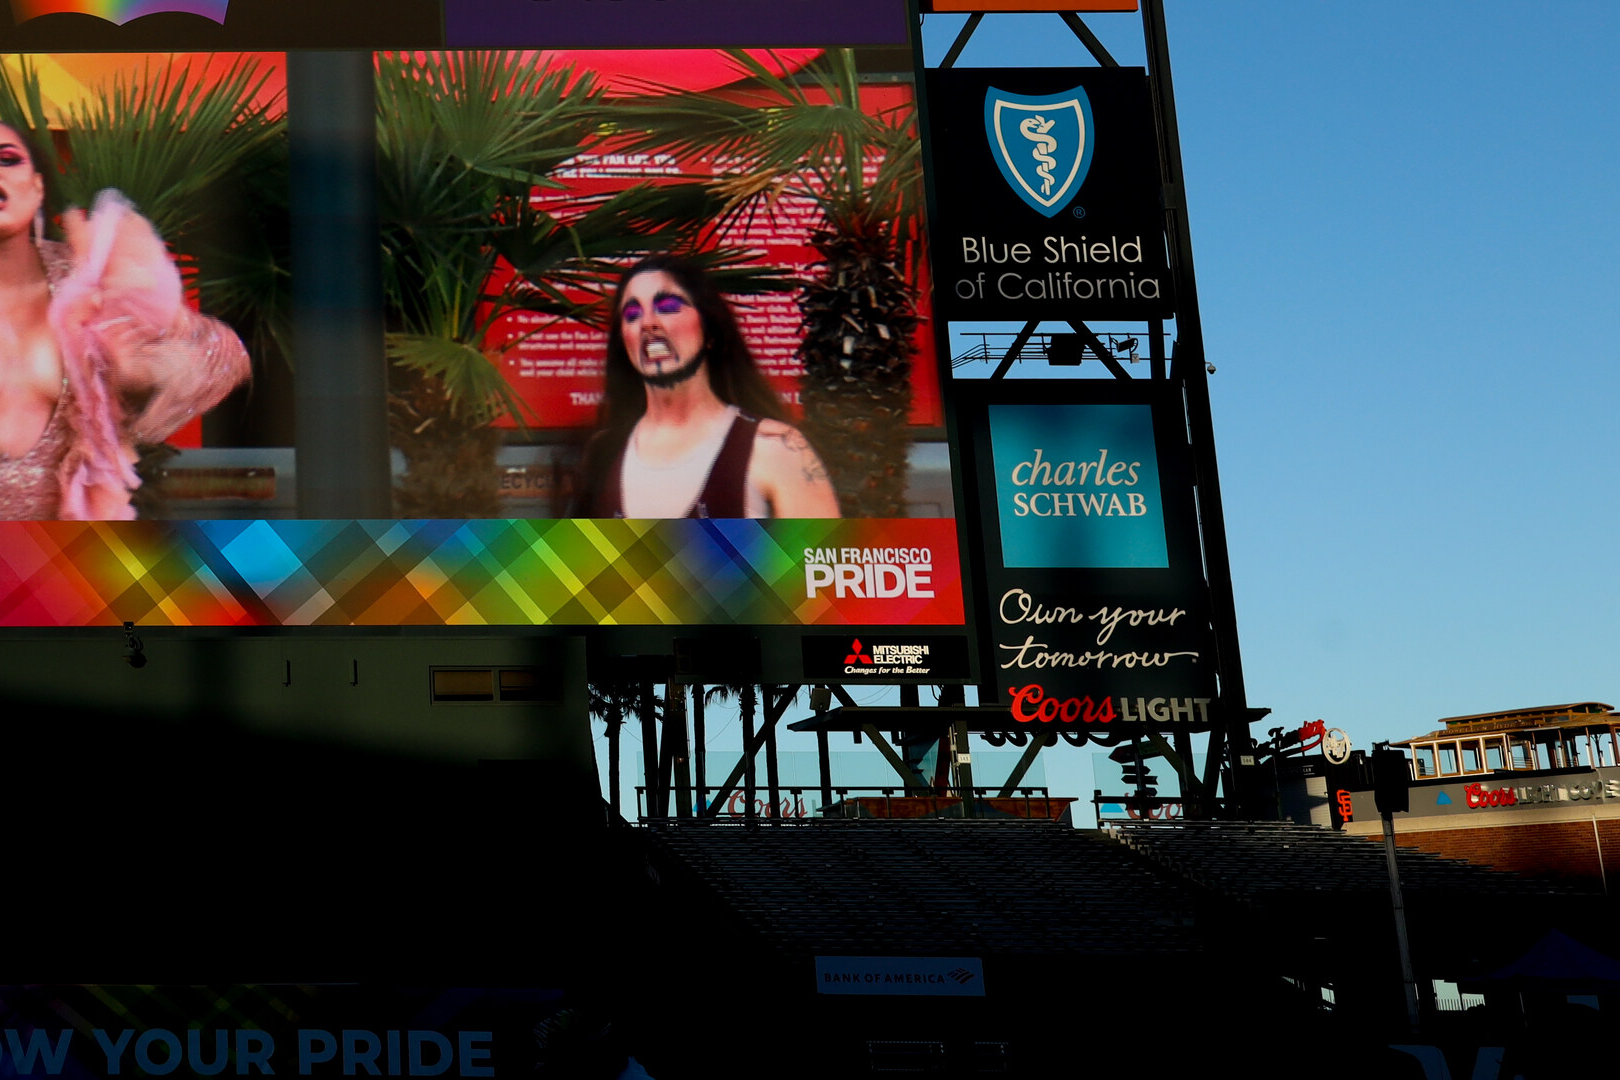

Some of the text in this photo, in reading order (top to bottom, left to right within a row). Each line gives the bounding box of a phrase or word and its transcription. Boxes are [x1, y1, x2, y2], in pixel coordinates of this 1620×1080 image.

[962, 235, 1143, 264] Blue Shield
[955, 271, 1160, 300] of California
[1012, 449, 1141, 486] charles
[1014, 492, 1147, 517] SCHWAB
[804, 547, 931, 564] SAN FRANCISCO
[805, 564, 935, 598] PRIDE
[1000, 588, 1186, 645] Own your
[873, 645, 930, 655] MITSUBISHI
[874, 655, 923, 664] ELECTRIC
[844, 665, 930, 675] Changes for the Better
[1008, 683, 1212, 723] Coors LIGHT
[1464, 783, 1518, 809] Coors
[824, 973, 946, 984] BANK OF AMERICA
[88, 1027, 277, 1076] YOUR
[297, 1027, 496, 1077] PRIDE
